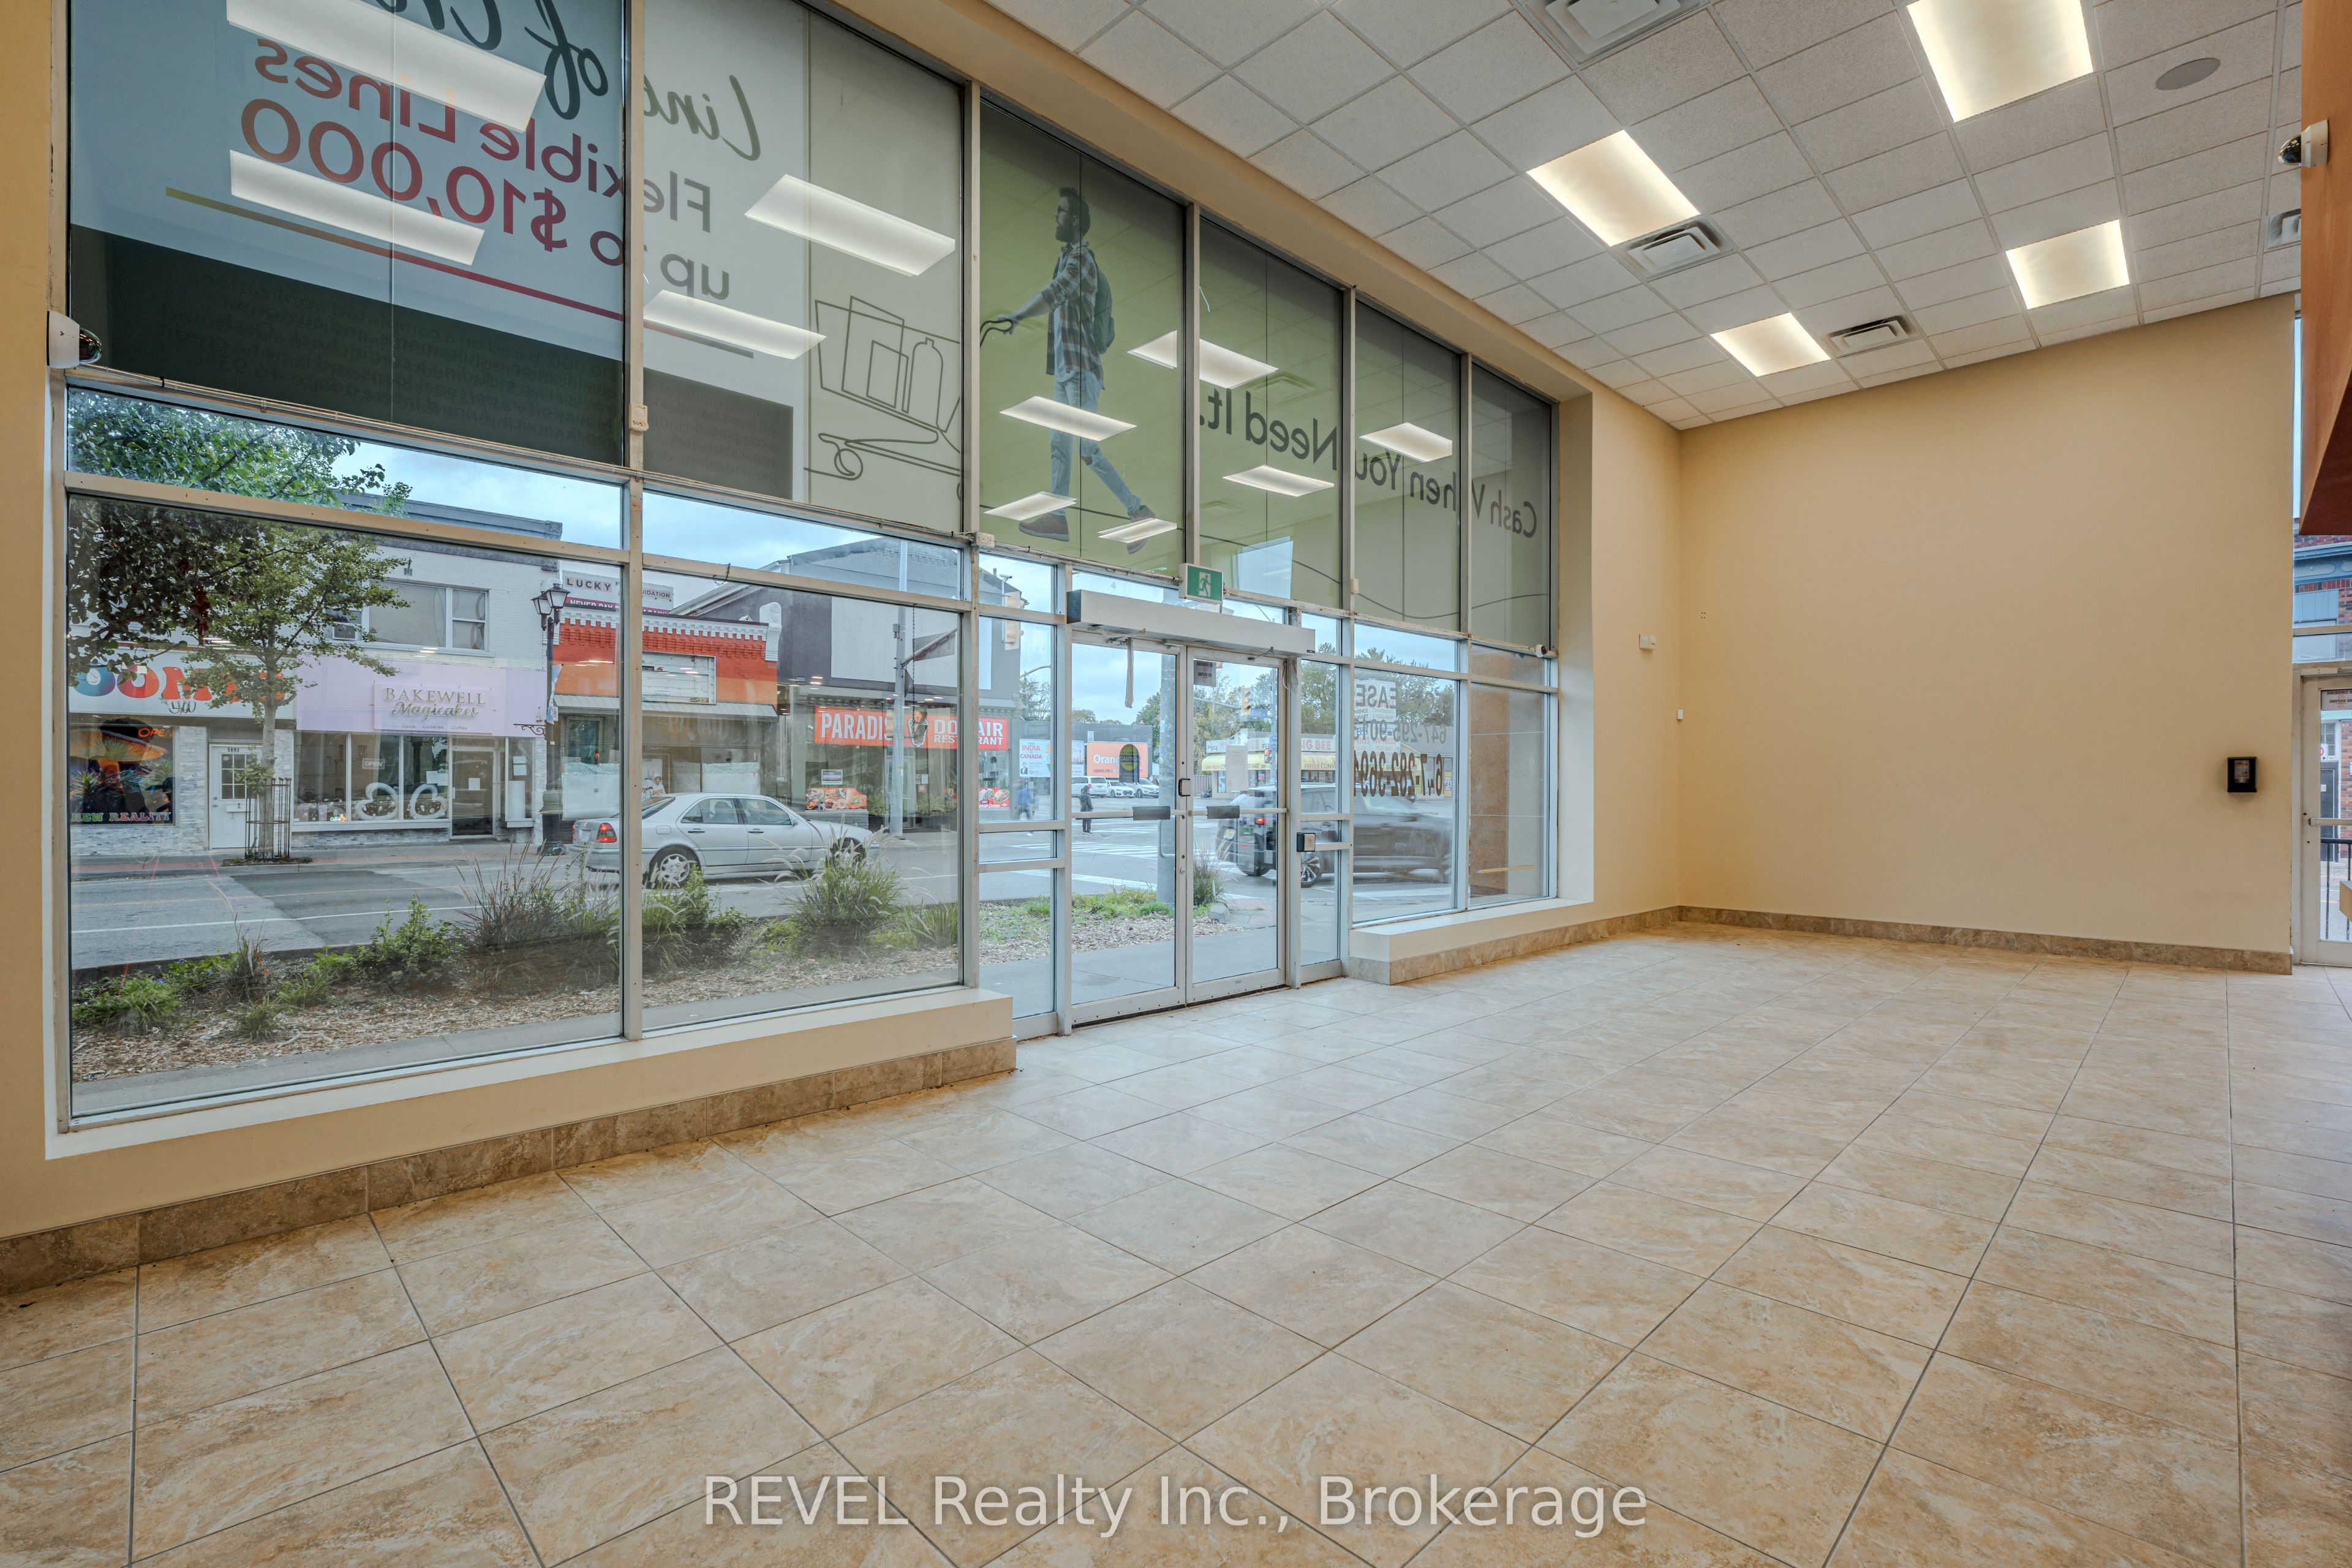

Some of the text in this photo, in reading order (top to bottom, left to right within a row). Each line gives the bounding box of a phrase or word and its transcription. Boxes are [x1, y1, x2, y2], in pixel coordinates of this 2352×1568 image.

[567, 578, 611, 591] LUCKY
[385, 687, 486, 704] BAKEWELL
[391, 701, 480, 721] Magicakes
[1315, 739, 1331, 750] BEE
[70, 812, 172, 822] NEW REALITY
